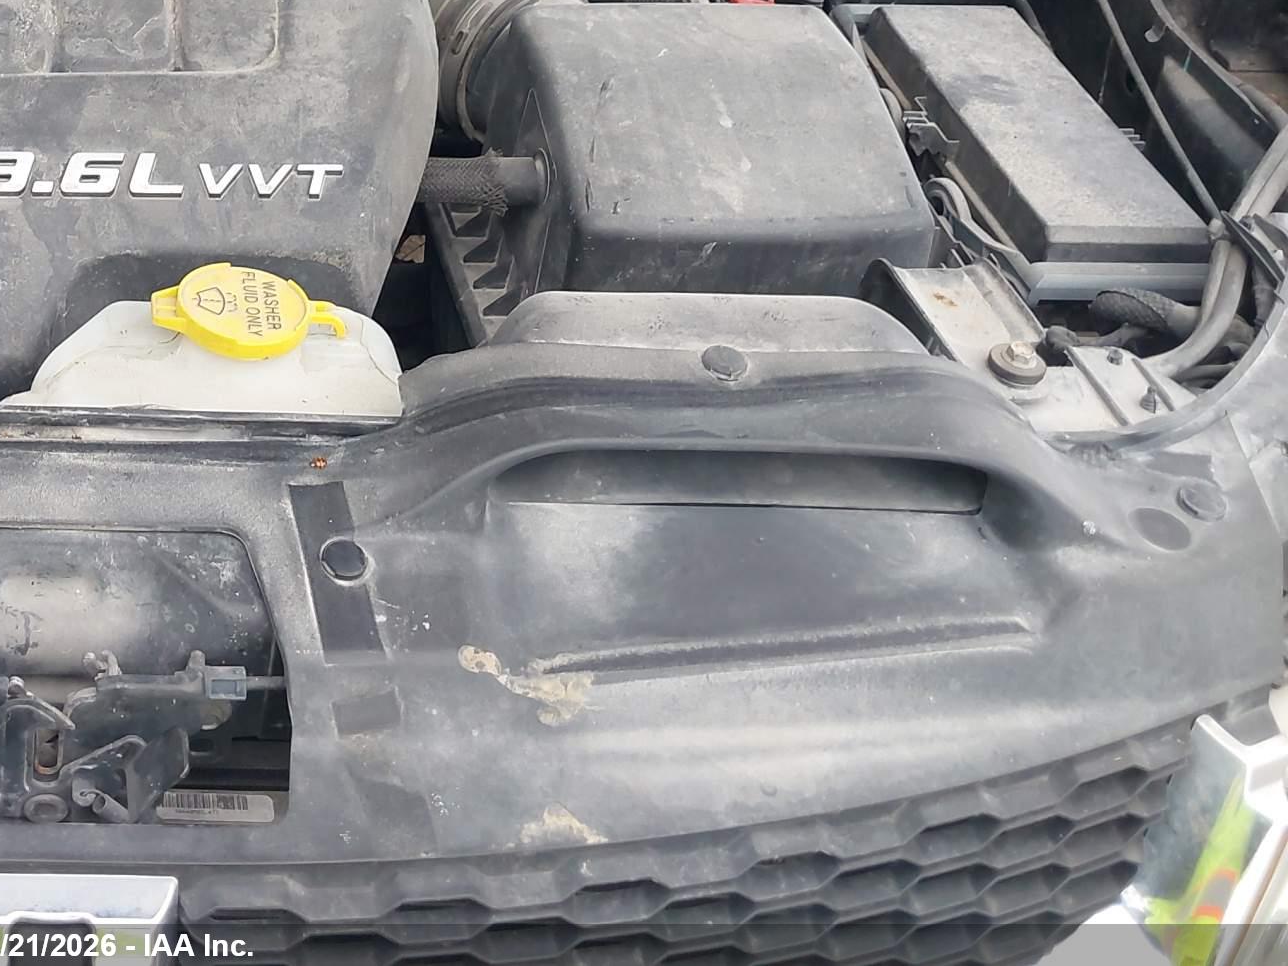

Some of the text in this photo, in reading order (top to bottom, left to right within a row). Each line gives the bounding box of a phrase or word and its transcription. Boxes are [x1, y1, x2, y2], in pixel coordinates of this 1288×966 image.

[198, 163, 344, 199] VVT
[242, 271, 264, 337] FLUID ONLY
[262, 281, 282, 331] WASHER
